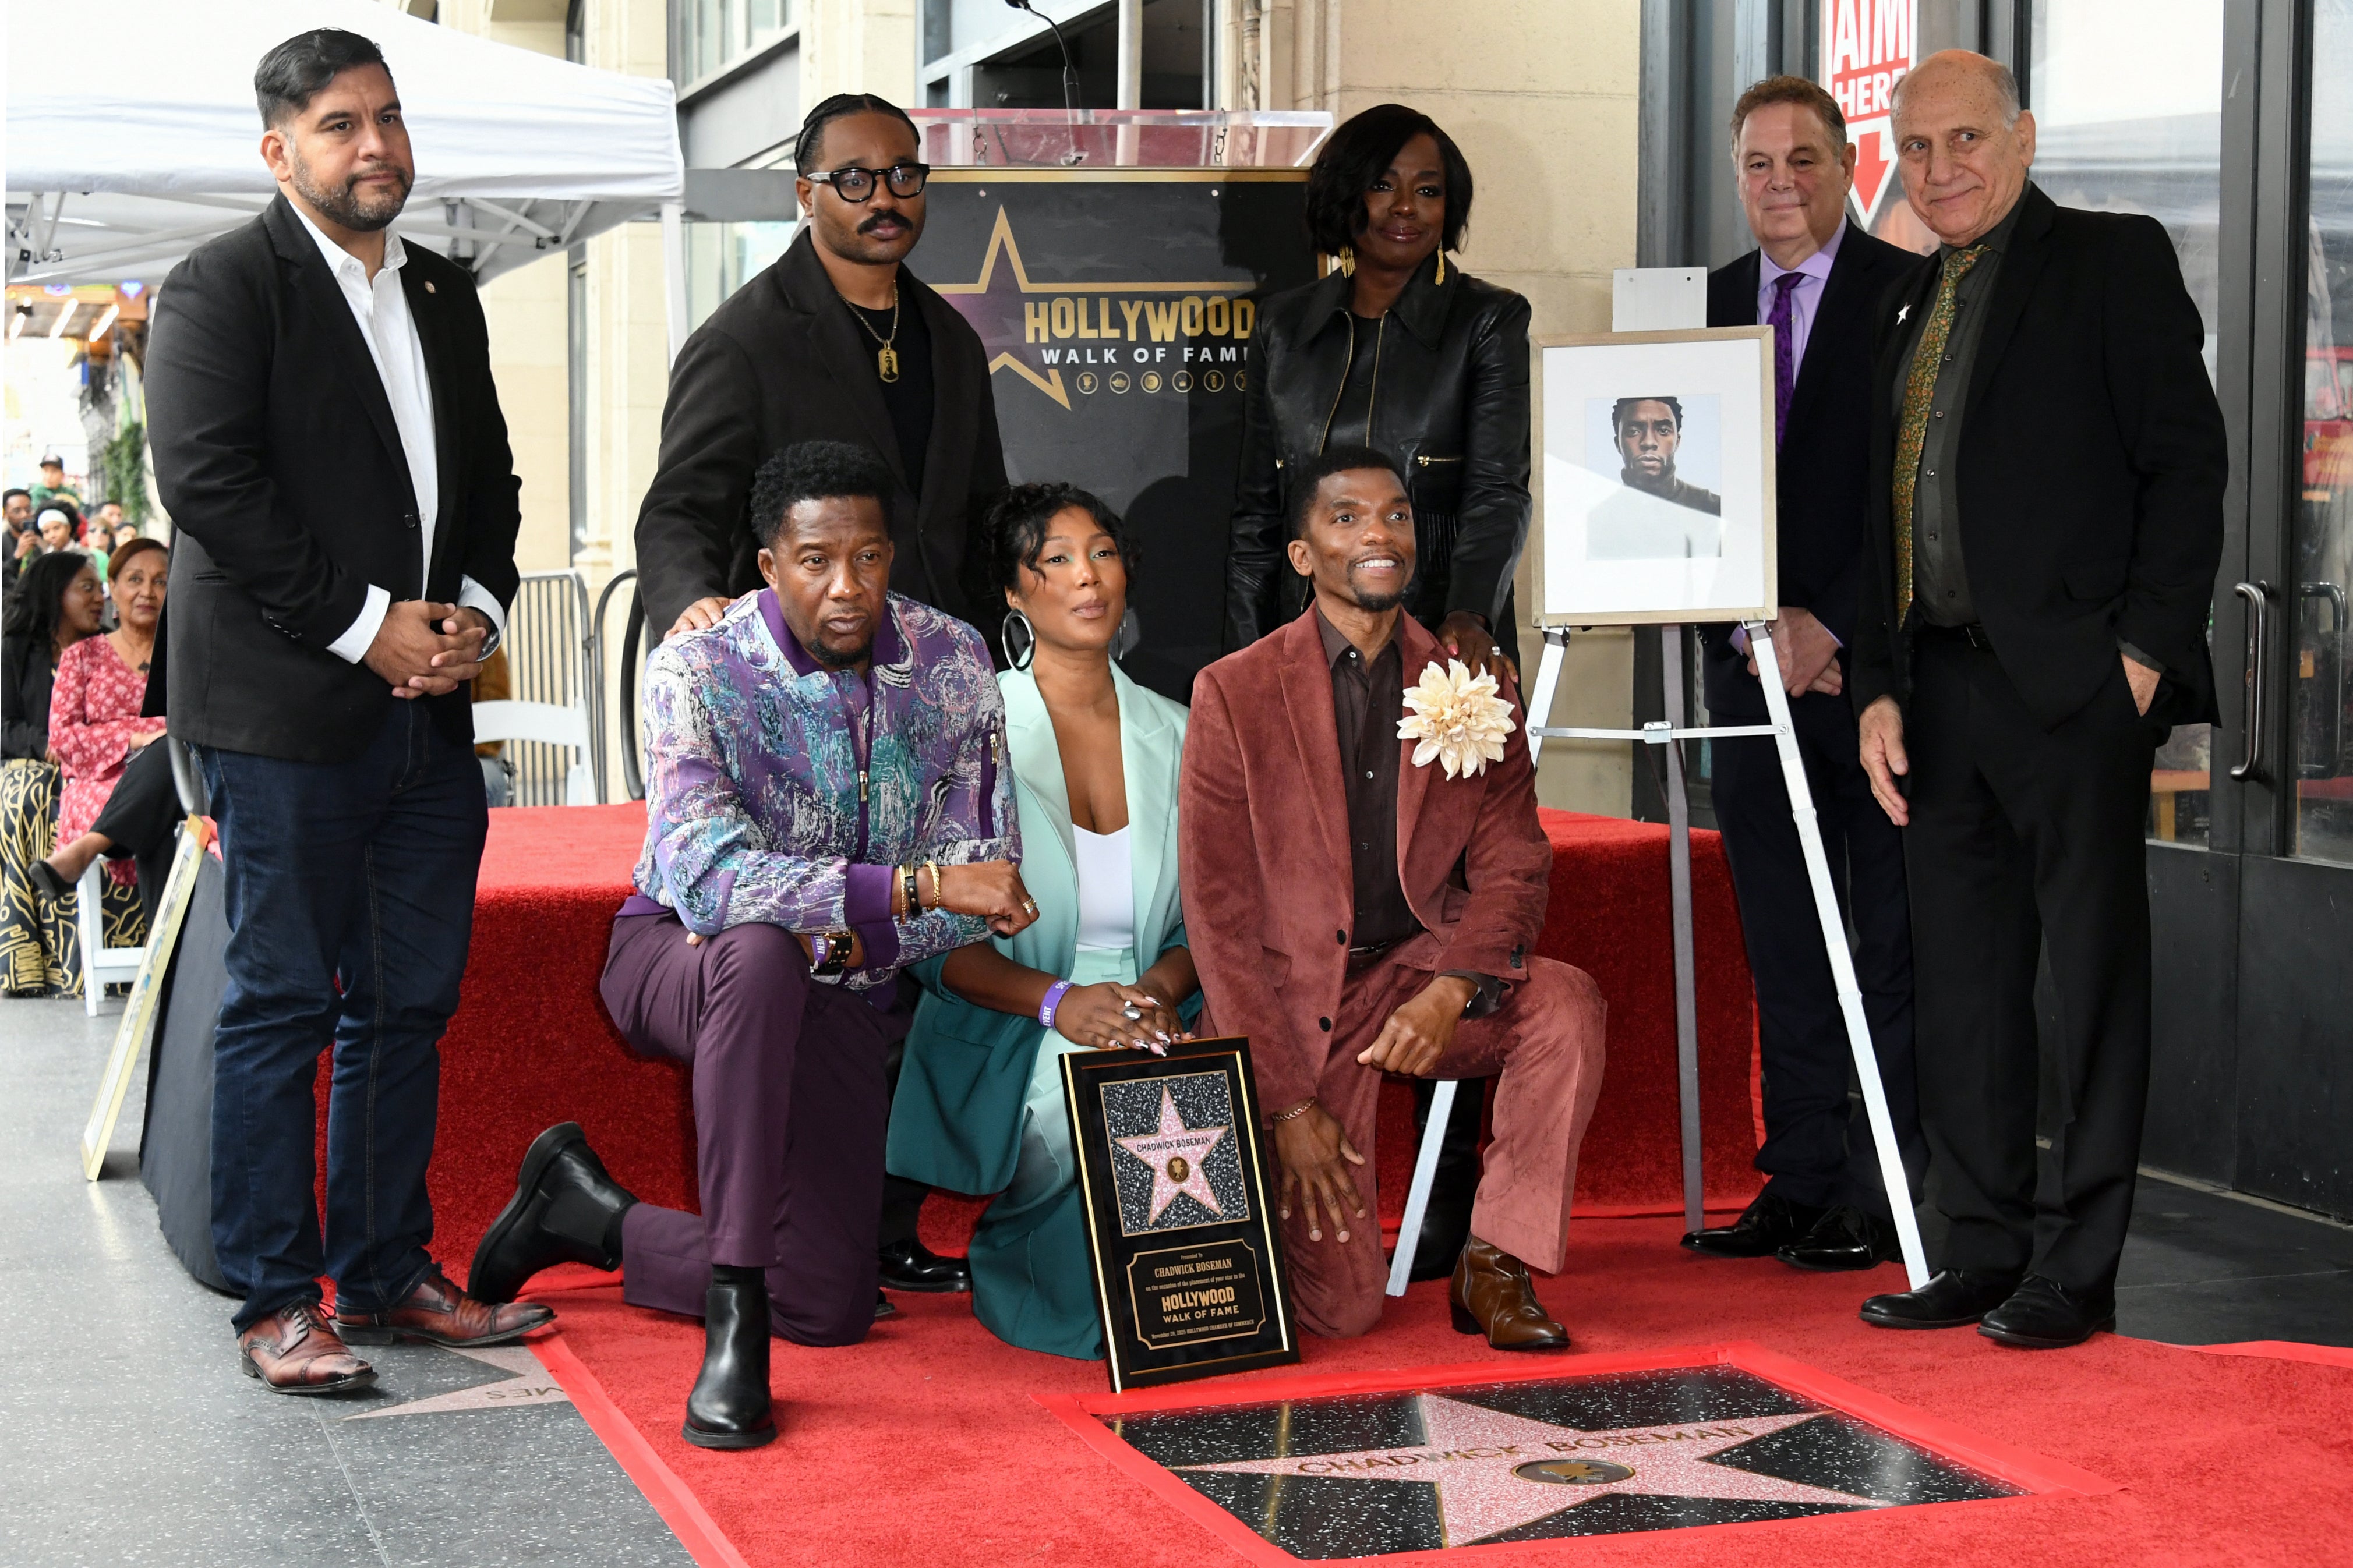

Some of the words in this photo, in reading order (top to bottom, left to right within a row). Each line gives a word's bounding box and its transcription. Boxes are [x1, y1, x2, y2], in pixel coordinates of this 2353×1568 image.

[1833, 0, 1908, 75] AIM
[1024, 296, 1255, 343] HOLLYWOOD
[1042, 349, 1117, 364] WALK
[1133, 348, 1166, 363] OF
[1183, 347, 1248, 362] FAM
[1043, 1006, 1052, 1027] EVENT
[1137, 1141, 1175, 1152] CHADWICK
[1176, 1137, 1210, 1148] BOSEMAN
[1154, 1263, 1195, 1278] CHADWICK
[1196, 1258, 1232, 1272] BOSEMAN
[1161, 1286, 1235, 1312] HOLLYWOOD
[1163, 1312, 1192, 1323] WALK
[1195, 1310, 1207, 1319] OF
[1210, 1305, 1239, 1317] FAME
[1298, 1445, 1538, 1473] CHADWICK
[1545, 1426, 1754, 1452] BOSEMAN
